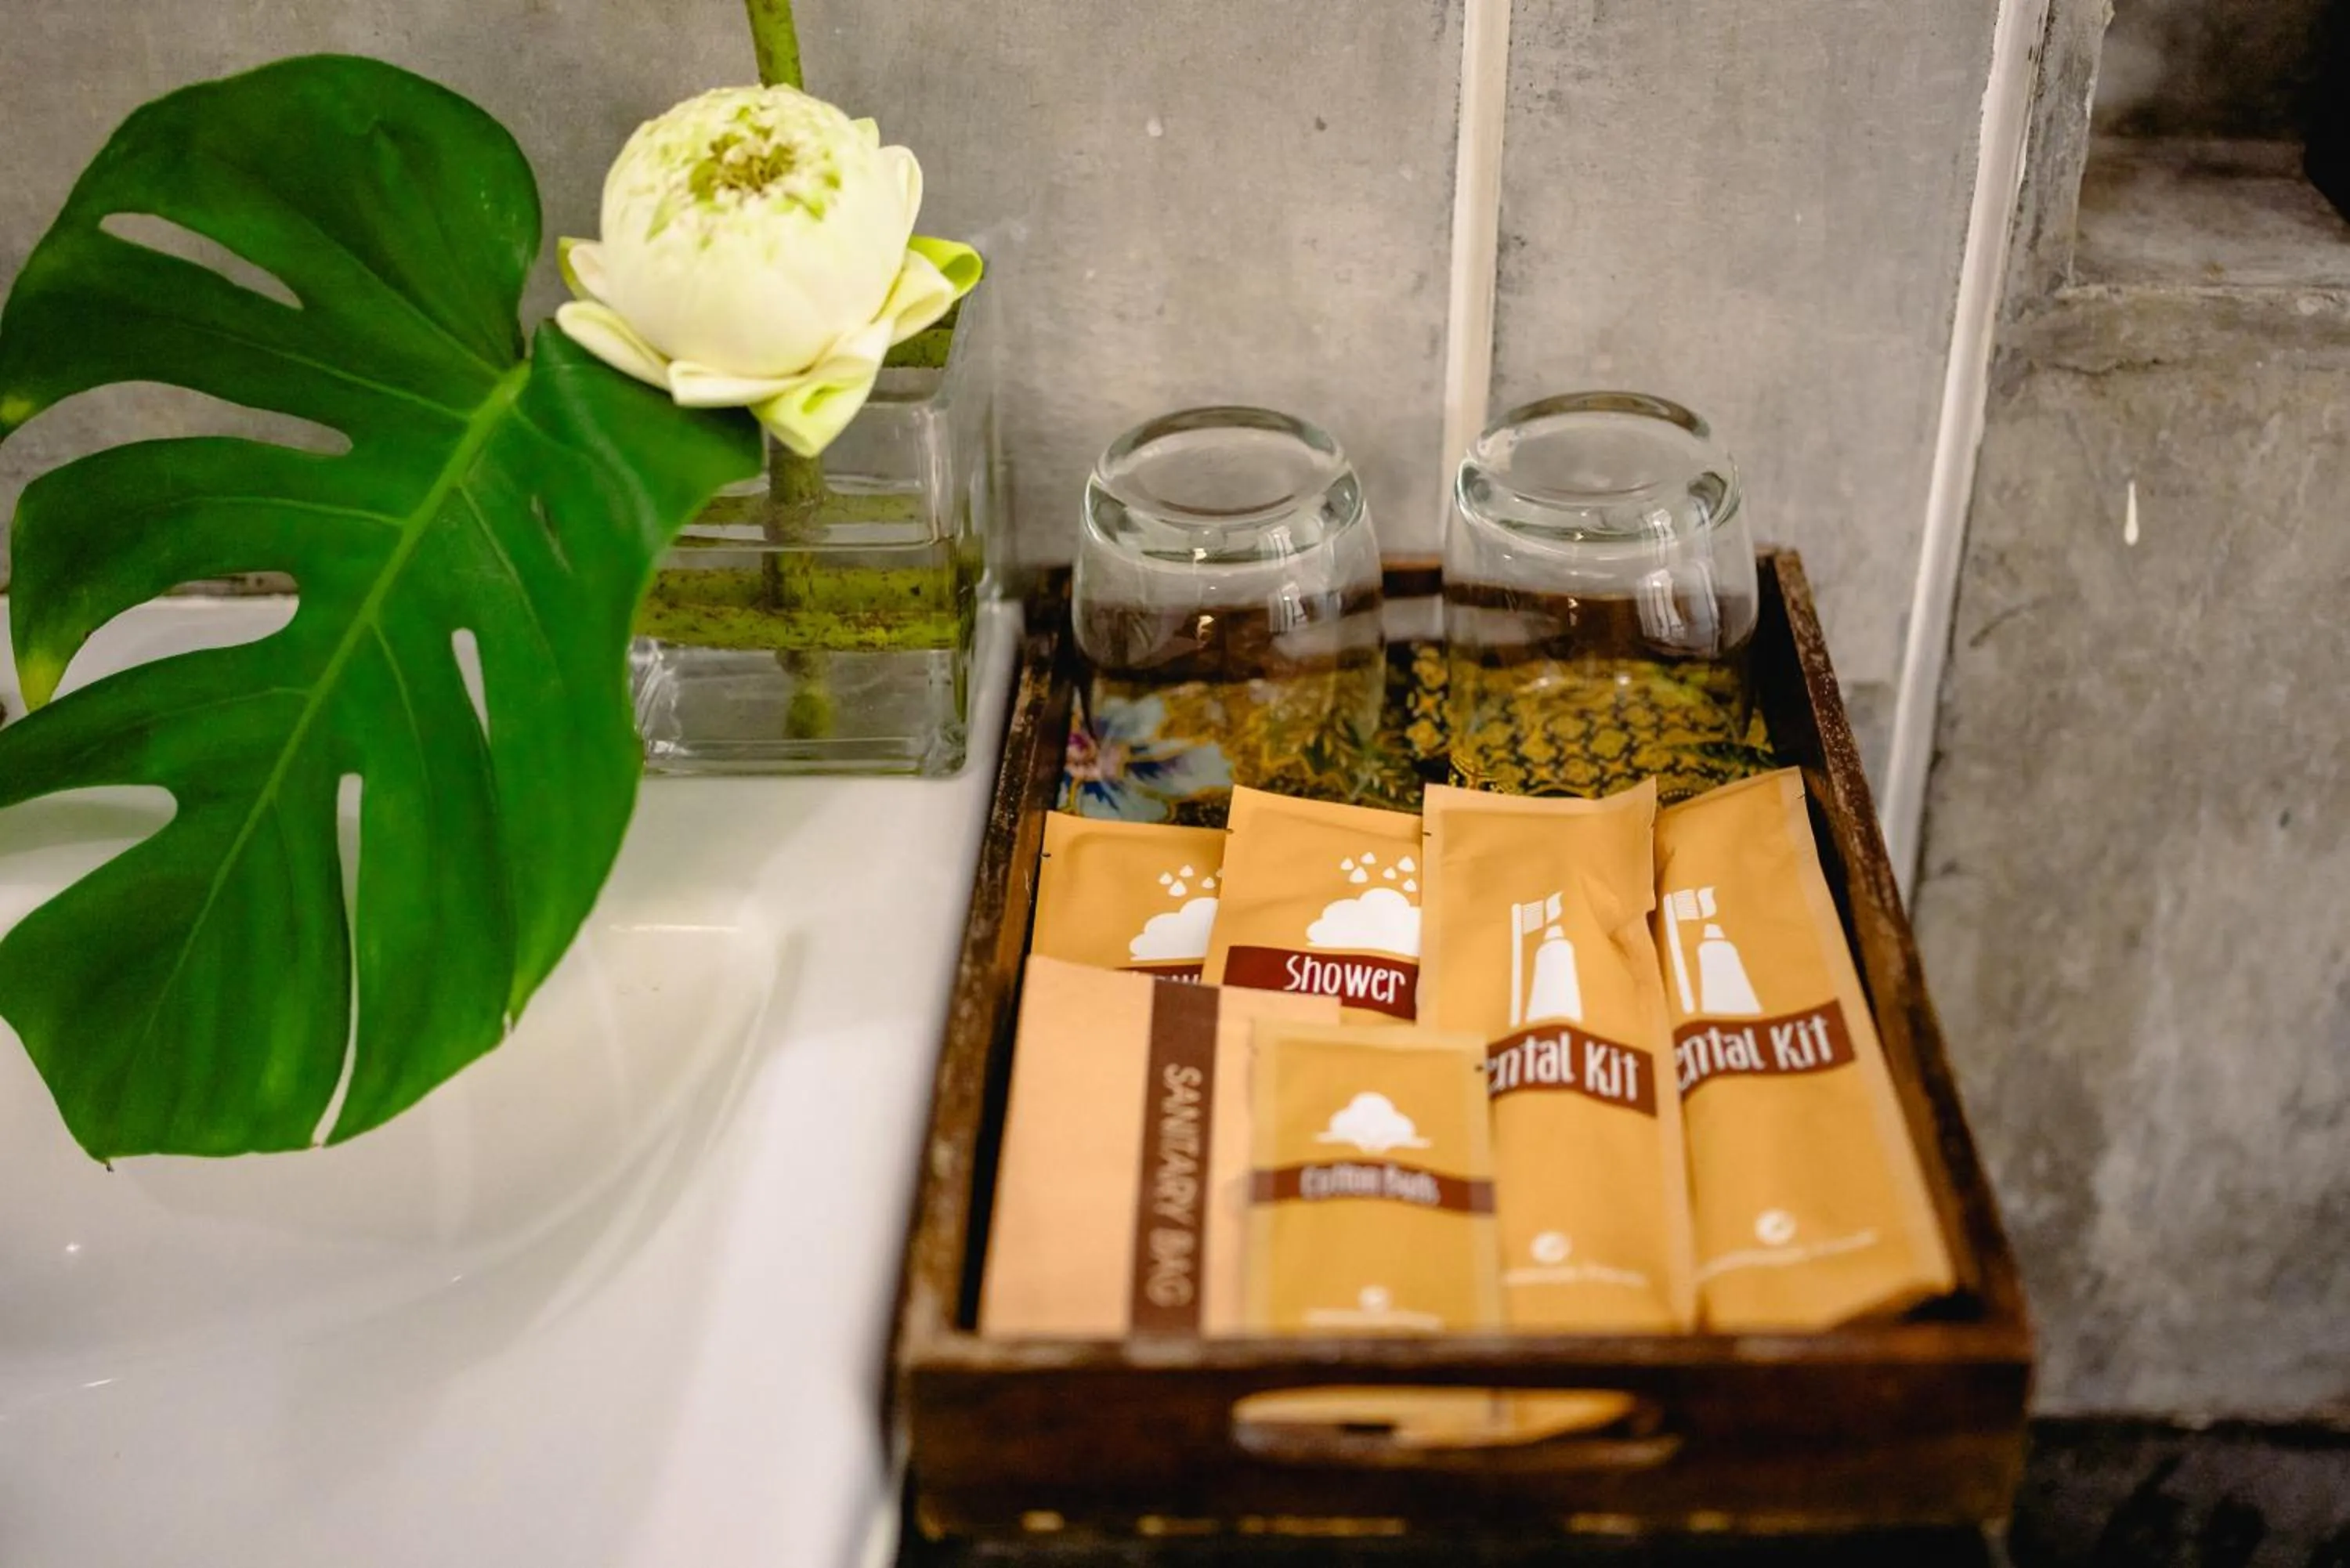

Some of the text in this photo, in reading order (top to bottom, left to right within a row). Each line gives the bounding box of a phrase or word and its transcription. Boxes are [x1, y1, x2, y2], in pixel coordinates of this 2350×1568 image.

[1282, 954, 1406, 1004] Shower
[1585, 1040, 1640, 1102] Kit
[1770, 1013, 1834, 1071] Kit
[1144, 1063, 1203, 1308] SANITARY BAG
